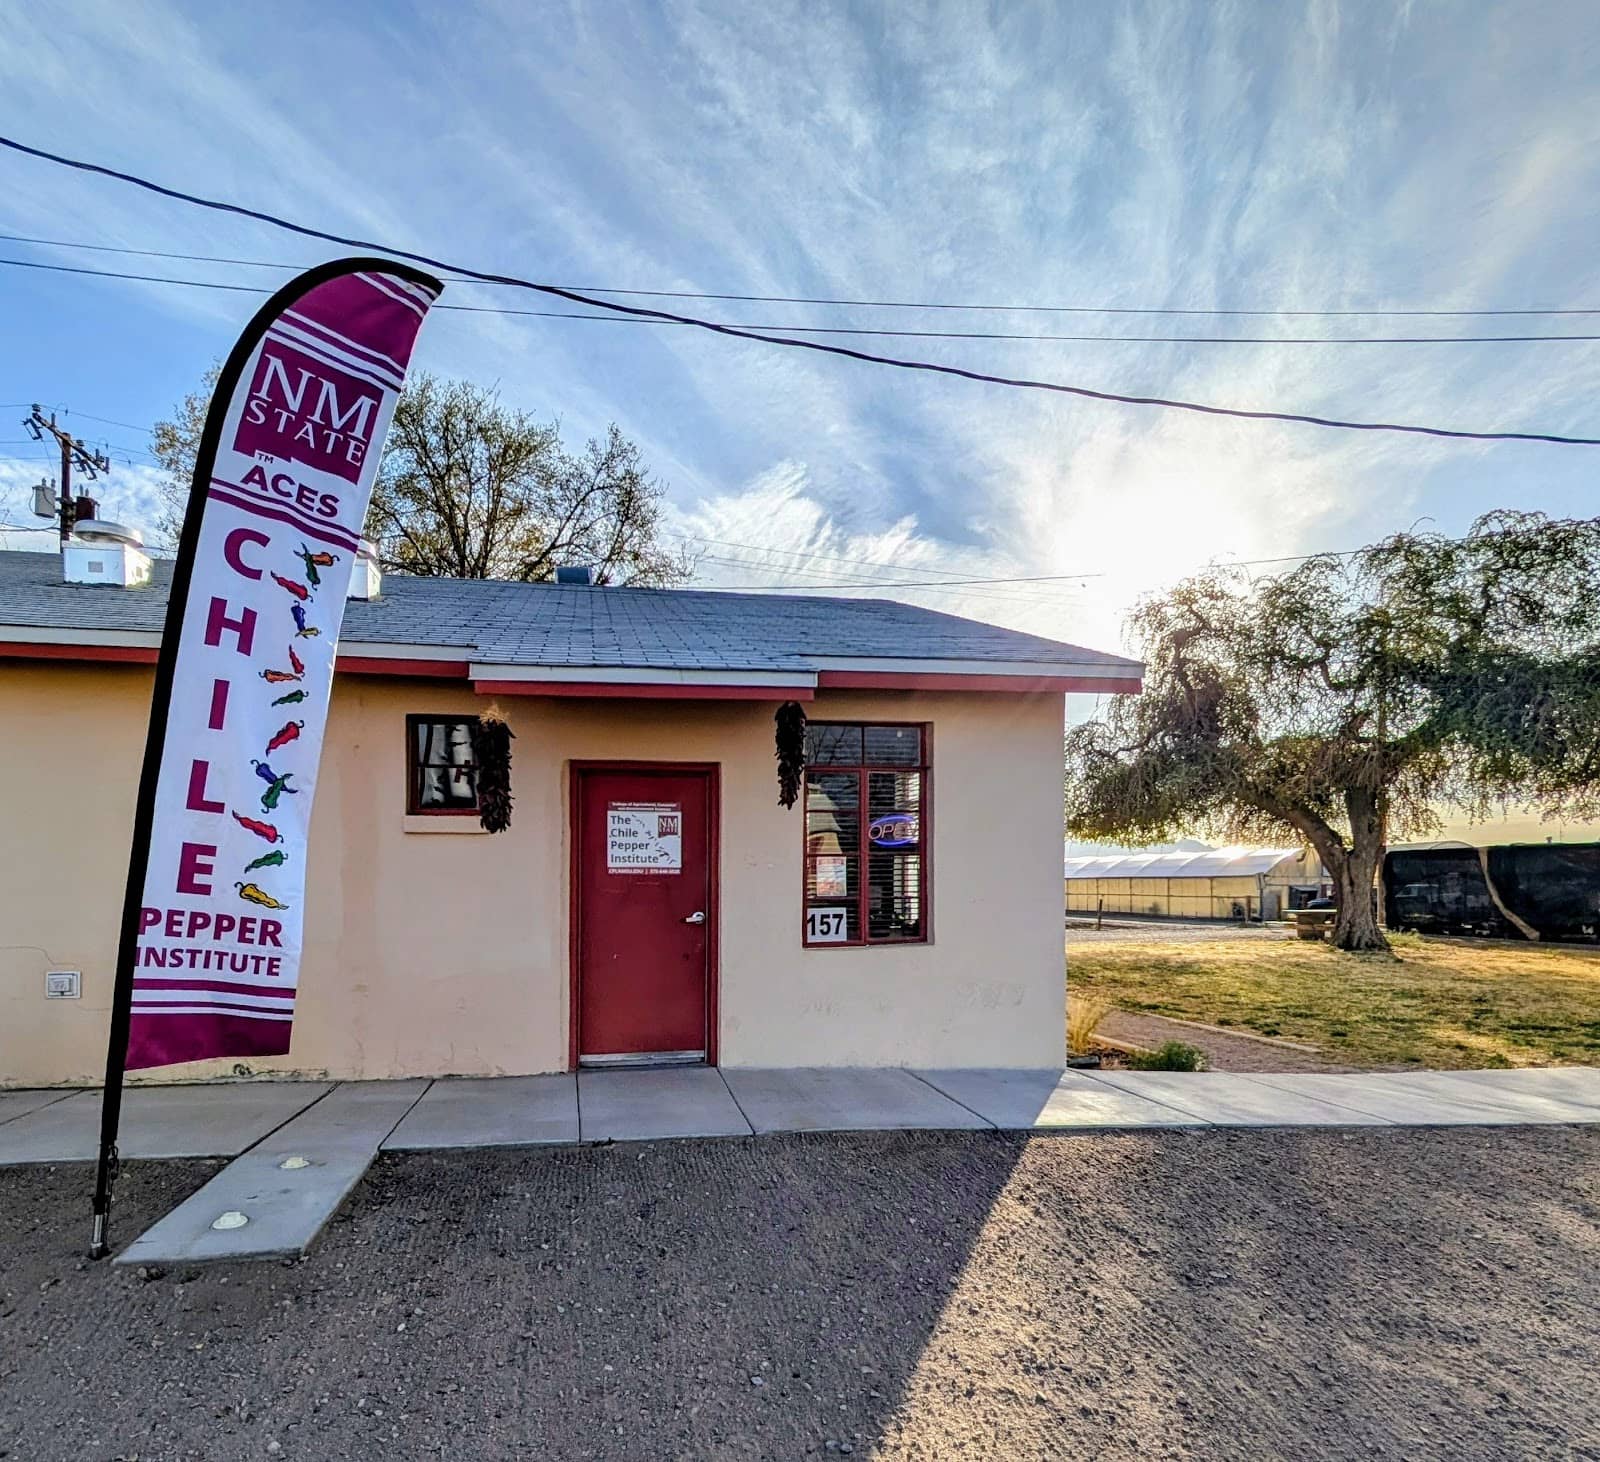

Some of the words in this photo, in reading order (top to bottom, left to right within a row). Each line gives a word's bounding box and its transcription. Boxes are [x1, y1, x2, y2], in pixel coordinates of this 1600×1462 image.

[252, 353, 378, 443] NM
[246, 400, 367, 467] STATE
[257, 452, 274, 464] TM
[240, 464, 340, 518] ACES
[175, 527, 271, 896] CHILE
[610, 815, 631, 825] The
[659, 817, 678, 827] NM
[610, 828, 638, 838] Chile
[610, 840, 650, 852] Pepper
[610, 854, 659, 864] Institute
[138, 907, 283, 947] PEPPER
[807, 913, 844, 936] 157
[134, 946, 281, 977] INSTITUTE
